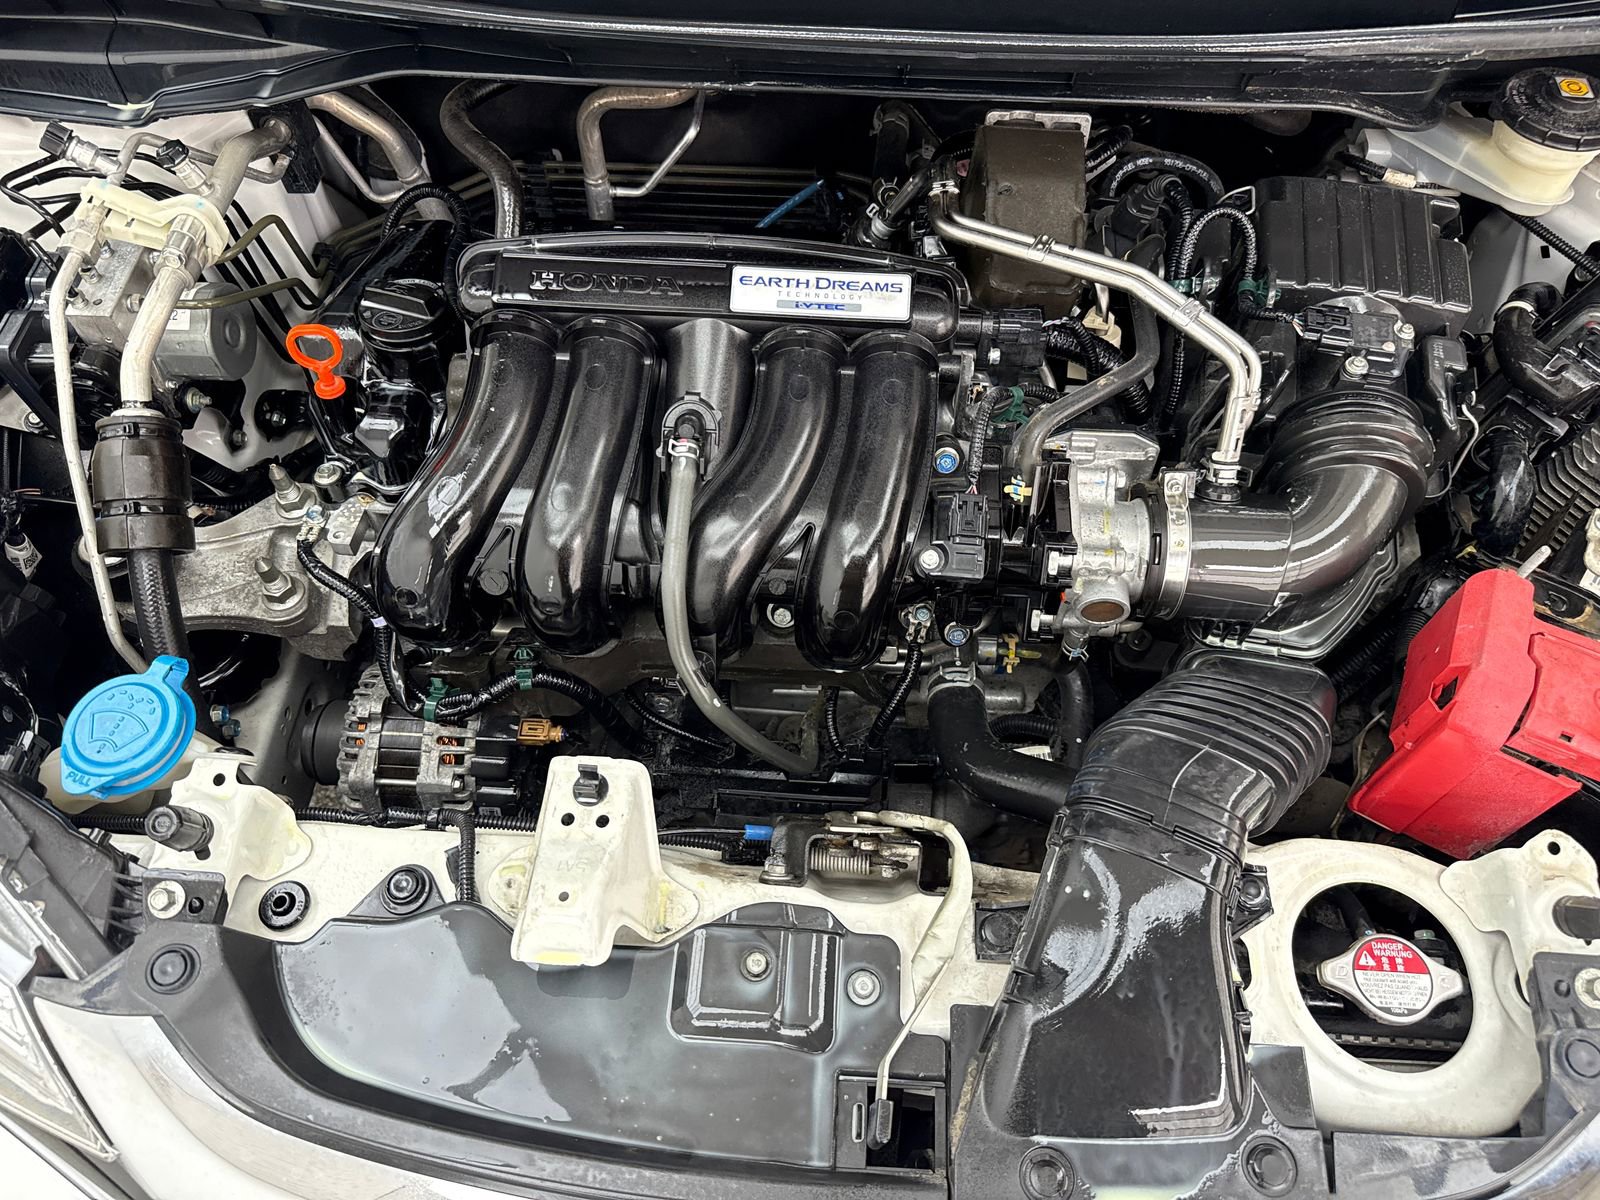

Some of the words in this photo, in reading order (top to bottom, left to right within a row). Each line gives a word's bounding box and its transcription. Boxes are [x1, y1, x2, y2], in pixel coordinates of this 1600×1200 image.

[530, 269, 684, 296] HONDA
[739, 275, 810, 289] EARTH
[815, 277, 903, 293] DREAMS
[778, 290, 862, 301] TECHNOLOGY
[65, 771, 92, 788] PULL
[1371, 941, 1403, 950] DANGER
[1374, 949, 1413, 959] WARNUNG
